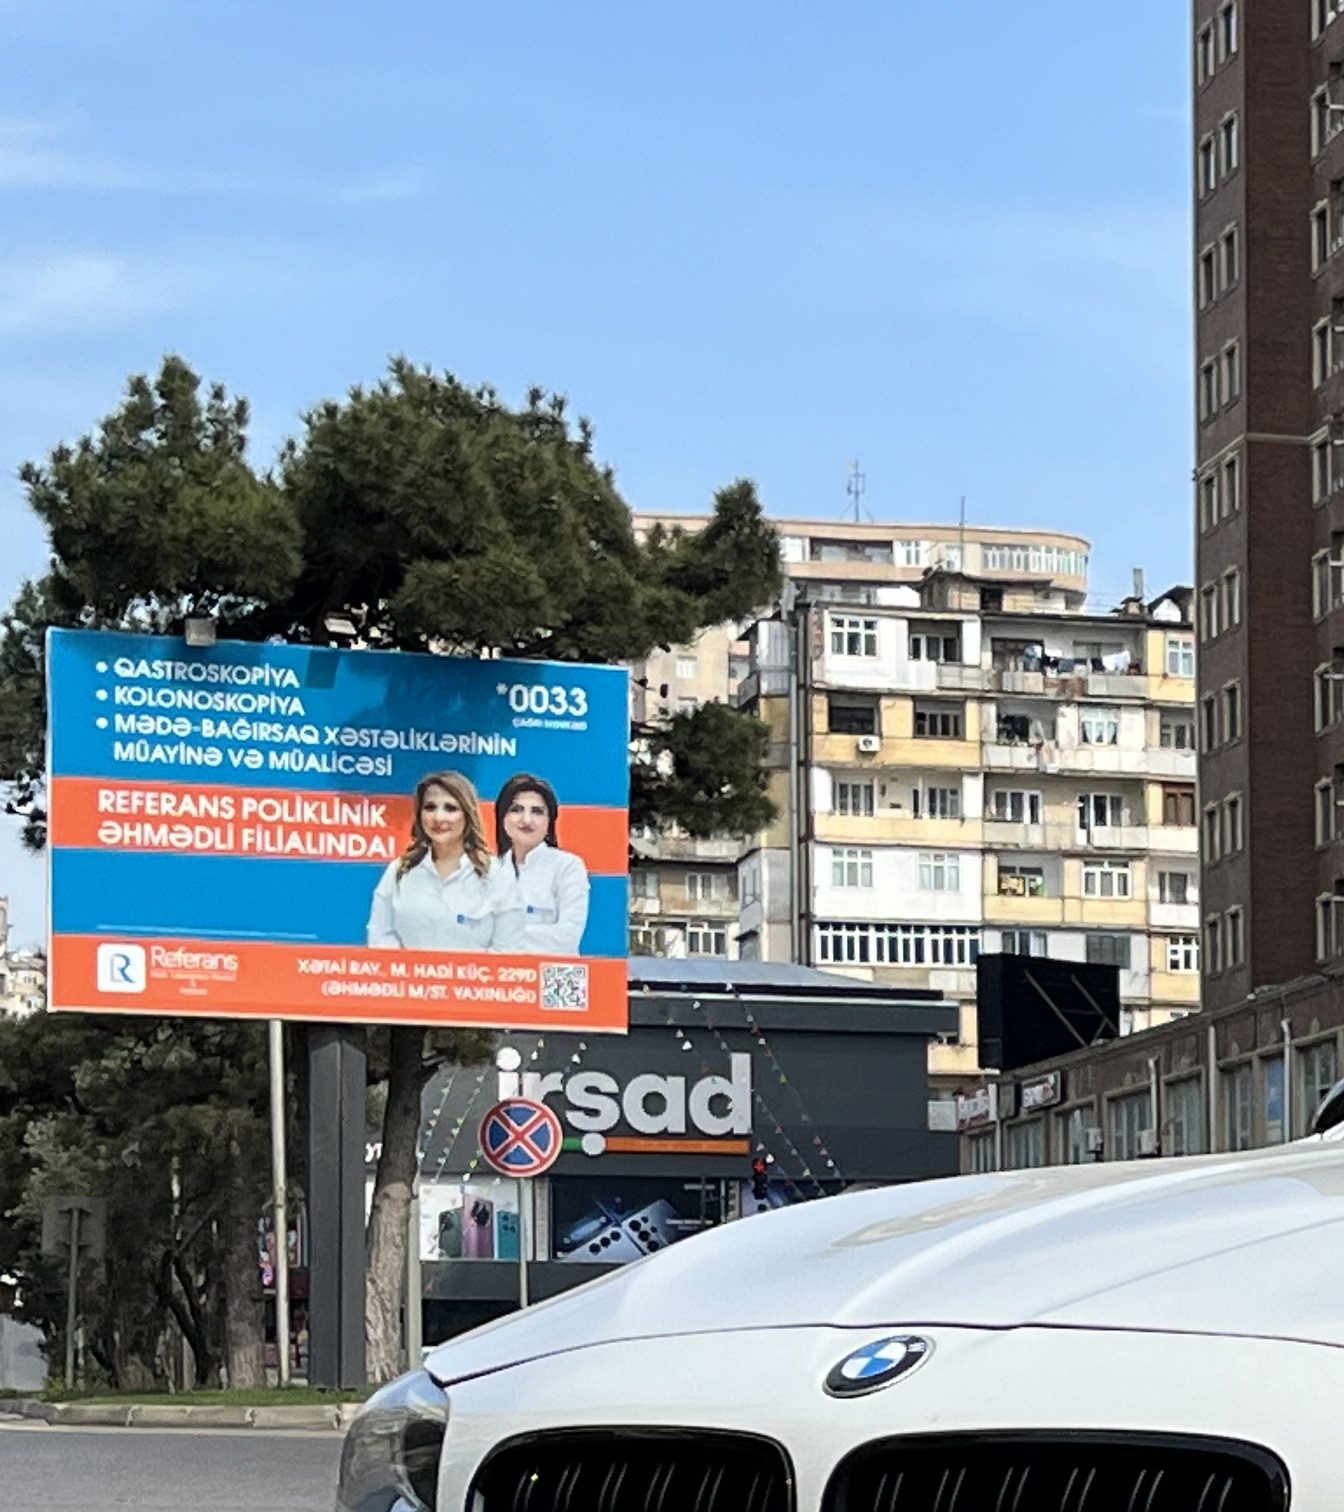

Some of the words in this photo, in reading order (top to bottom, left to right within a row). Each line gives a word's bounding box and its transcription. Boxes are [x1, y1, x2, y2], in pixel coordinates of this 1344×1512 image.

[113, 657, 300, 689] QASTROSKOPİYA
[113, 685, 305, 717] KOLONOSKOPİYA
[113, 739, 223, 767] MÜAYİNƏ
[226, 747, 265, 769] VƏ
[268, 748, 393, 777] MÜALİCƏSİ
[323, 725, 517, 758] XƏSTƏLİKLƏRİNİN
[97, 788, 236, 820] REFERANS
[241, 795, 387, 829] POLİKLİNİK
[97, 820, 235, 851] ƏHMƏDLİ
[241, 824, 397, 858] FİLİALINDA!
[150, 944, 239, 972] Referans
[496, 1046, 752, 1156] irşad
